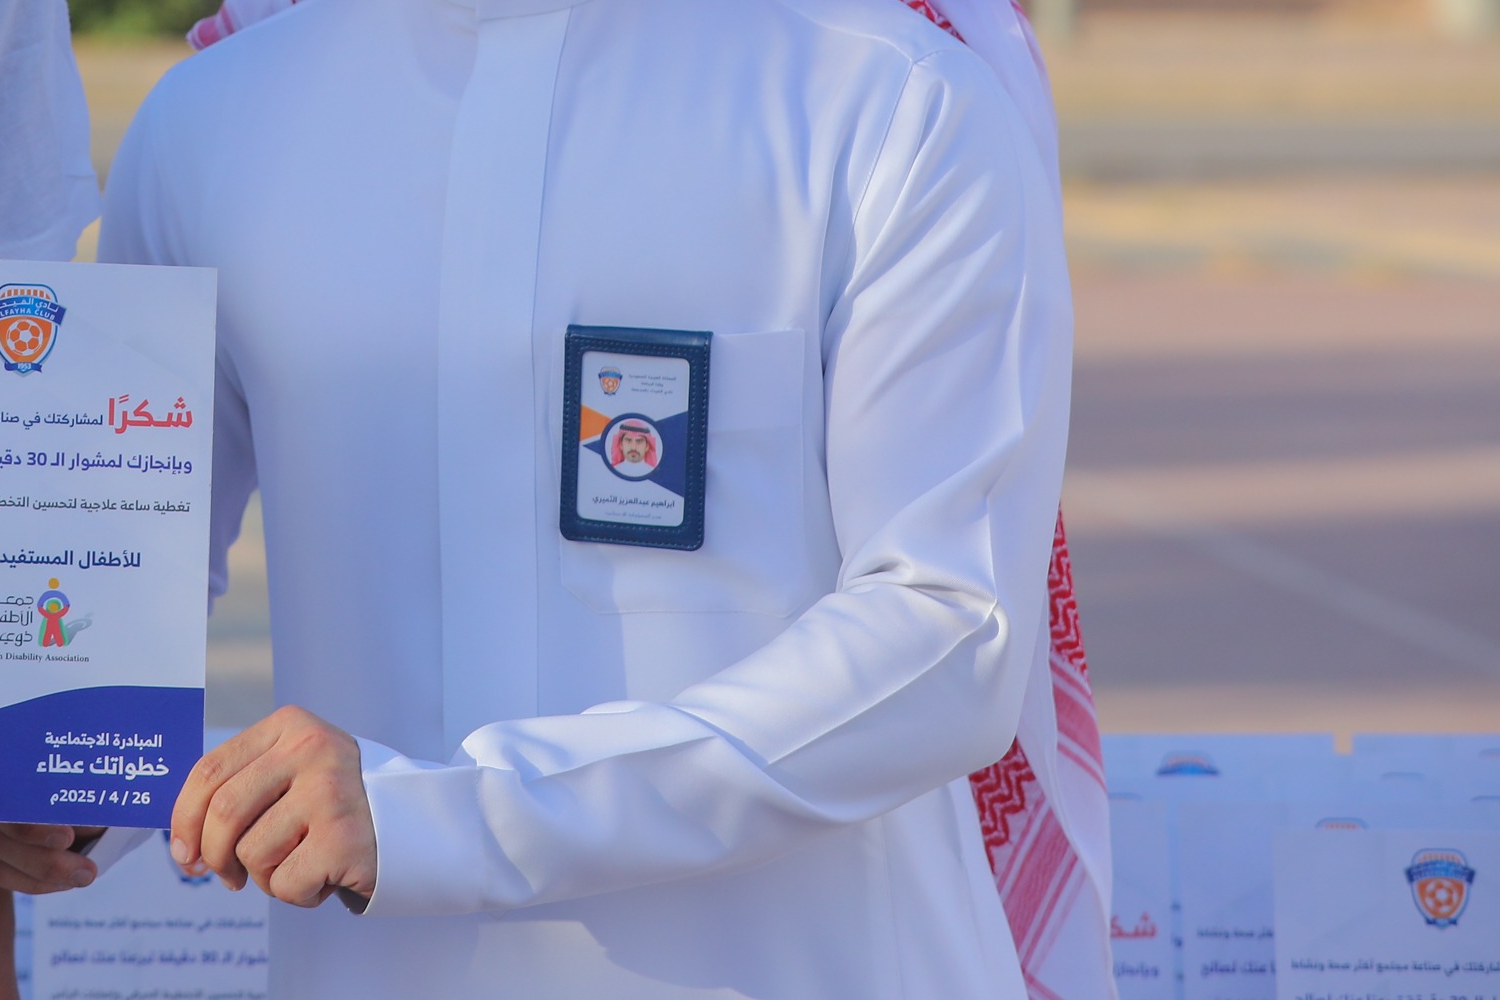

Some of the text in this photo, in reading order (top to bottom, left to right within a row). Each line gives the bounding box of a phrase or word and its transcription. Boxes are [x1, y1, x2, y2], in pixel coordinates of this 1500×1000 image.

[34, 309, 56, 321] CLUB
[22, 412, 41, 430] في
[44, 411, 104, 428] لمشاركتك
[108, 394, 193, 434] شكرًا
[26, 452, 47, 467] 30
[68, 451, 122, 471] لمشوار
[126, 454, 193, 475] وبإنجازك
[32, 498, 77, 511] لتحسين
[80, 498, 117, 513] علاجية
[120, 499, 150, 511] ساعة
[153, 500, 191, 515] تغطية
[79, 550, 141, 569] للأطفال
[5, 652, 43, 663] Disability
[44, 654, 90, 663] Association
[45, 731, 163, 750] المبادرة الاجتماعية
[36, 753, 170, 781] خطواتك عطاء
[49, 789, 96, 805] 2025م
[108, 790, 119, 803] 4
[131, 791, 151, 805] 26
